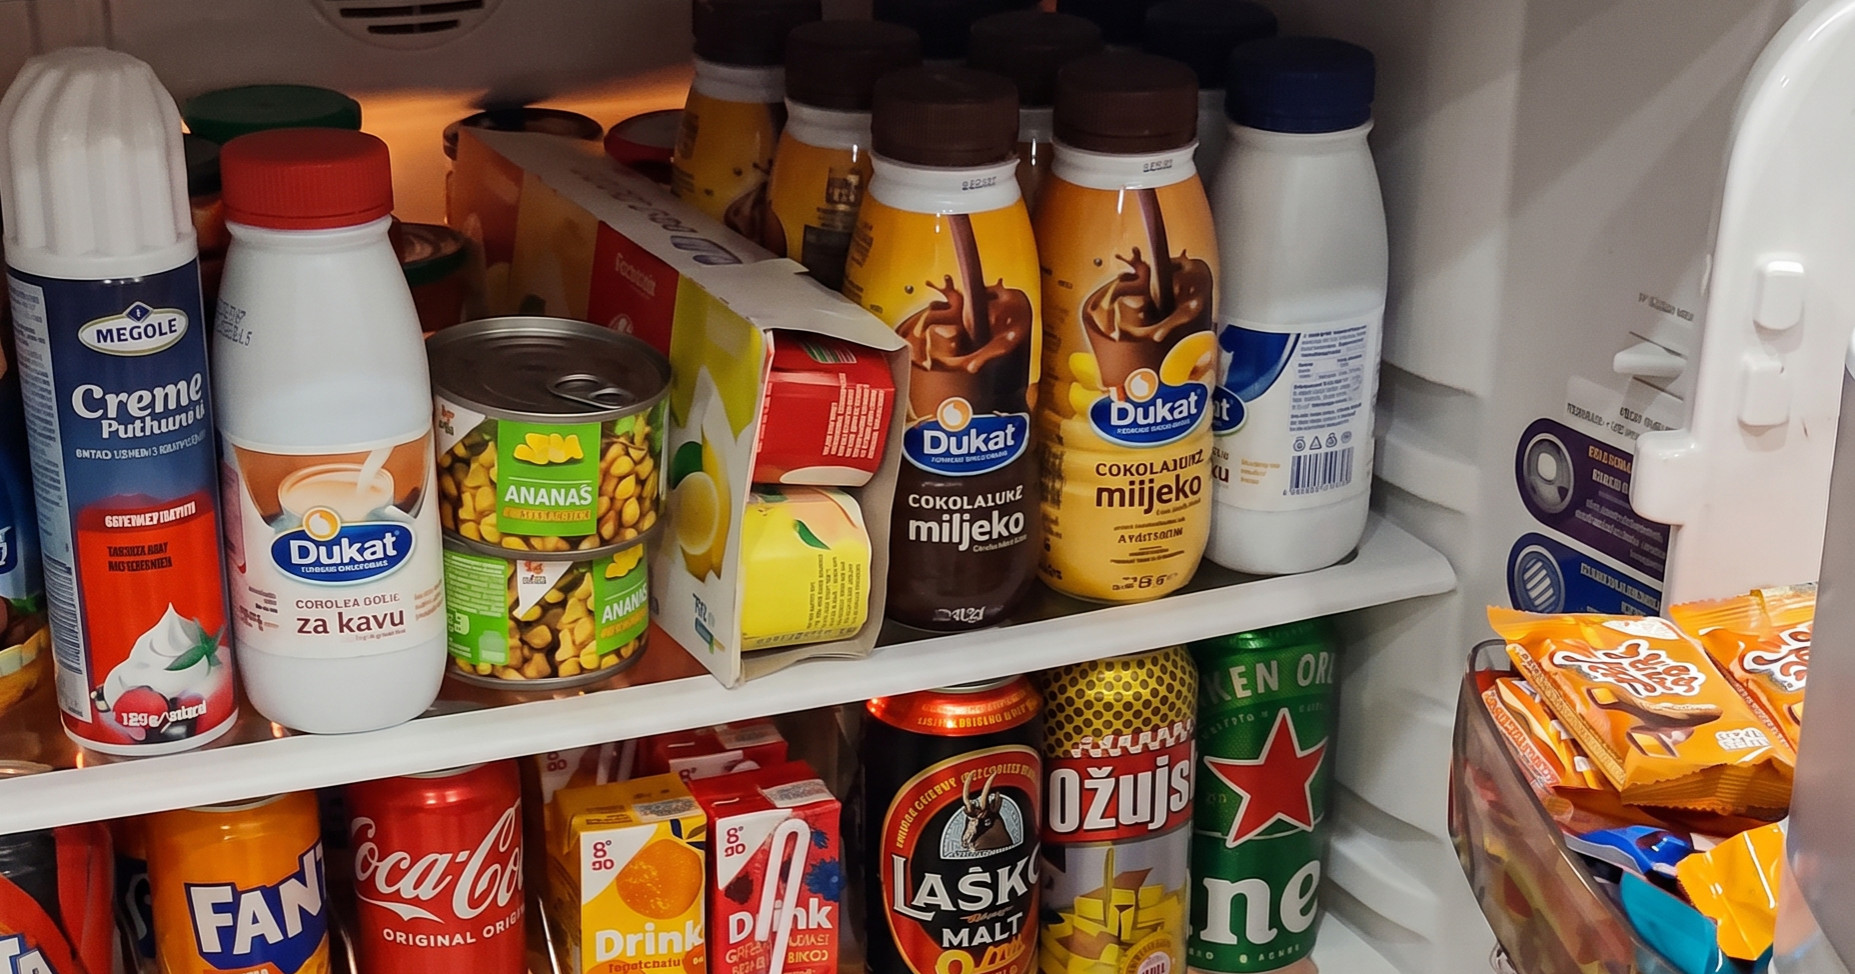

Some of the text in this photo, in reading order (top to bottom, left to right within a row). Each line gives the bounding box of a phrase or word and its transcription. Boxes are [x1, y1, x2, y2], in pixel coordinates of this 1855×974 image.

[95, 317, 178, 344] MEGOLE
[71, 373, 203, 419] Creme
[1110, 391, 1198, 426] Dukat
[923, 424, 1016, 455] Dukat
[908, 510, 1025, 551] miljeko
[289, 533, 398, 565] Dukat
[296, 610, 404, 634] za kavu
[383, 928, 477, 947] ORIGINAL
[728, 898, 833, 944] Dink
[942, 911, 1023, 948] MALT
[595, 919, 705, 962] Drink
